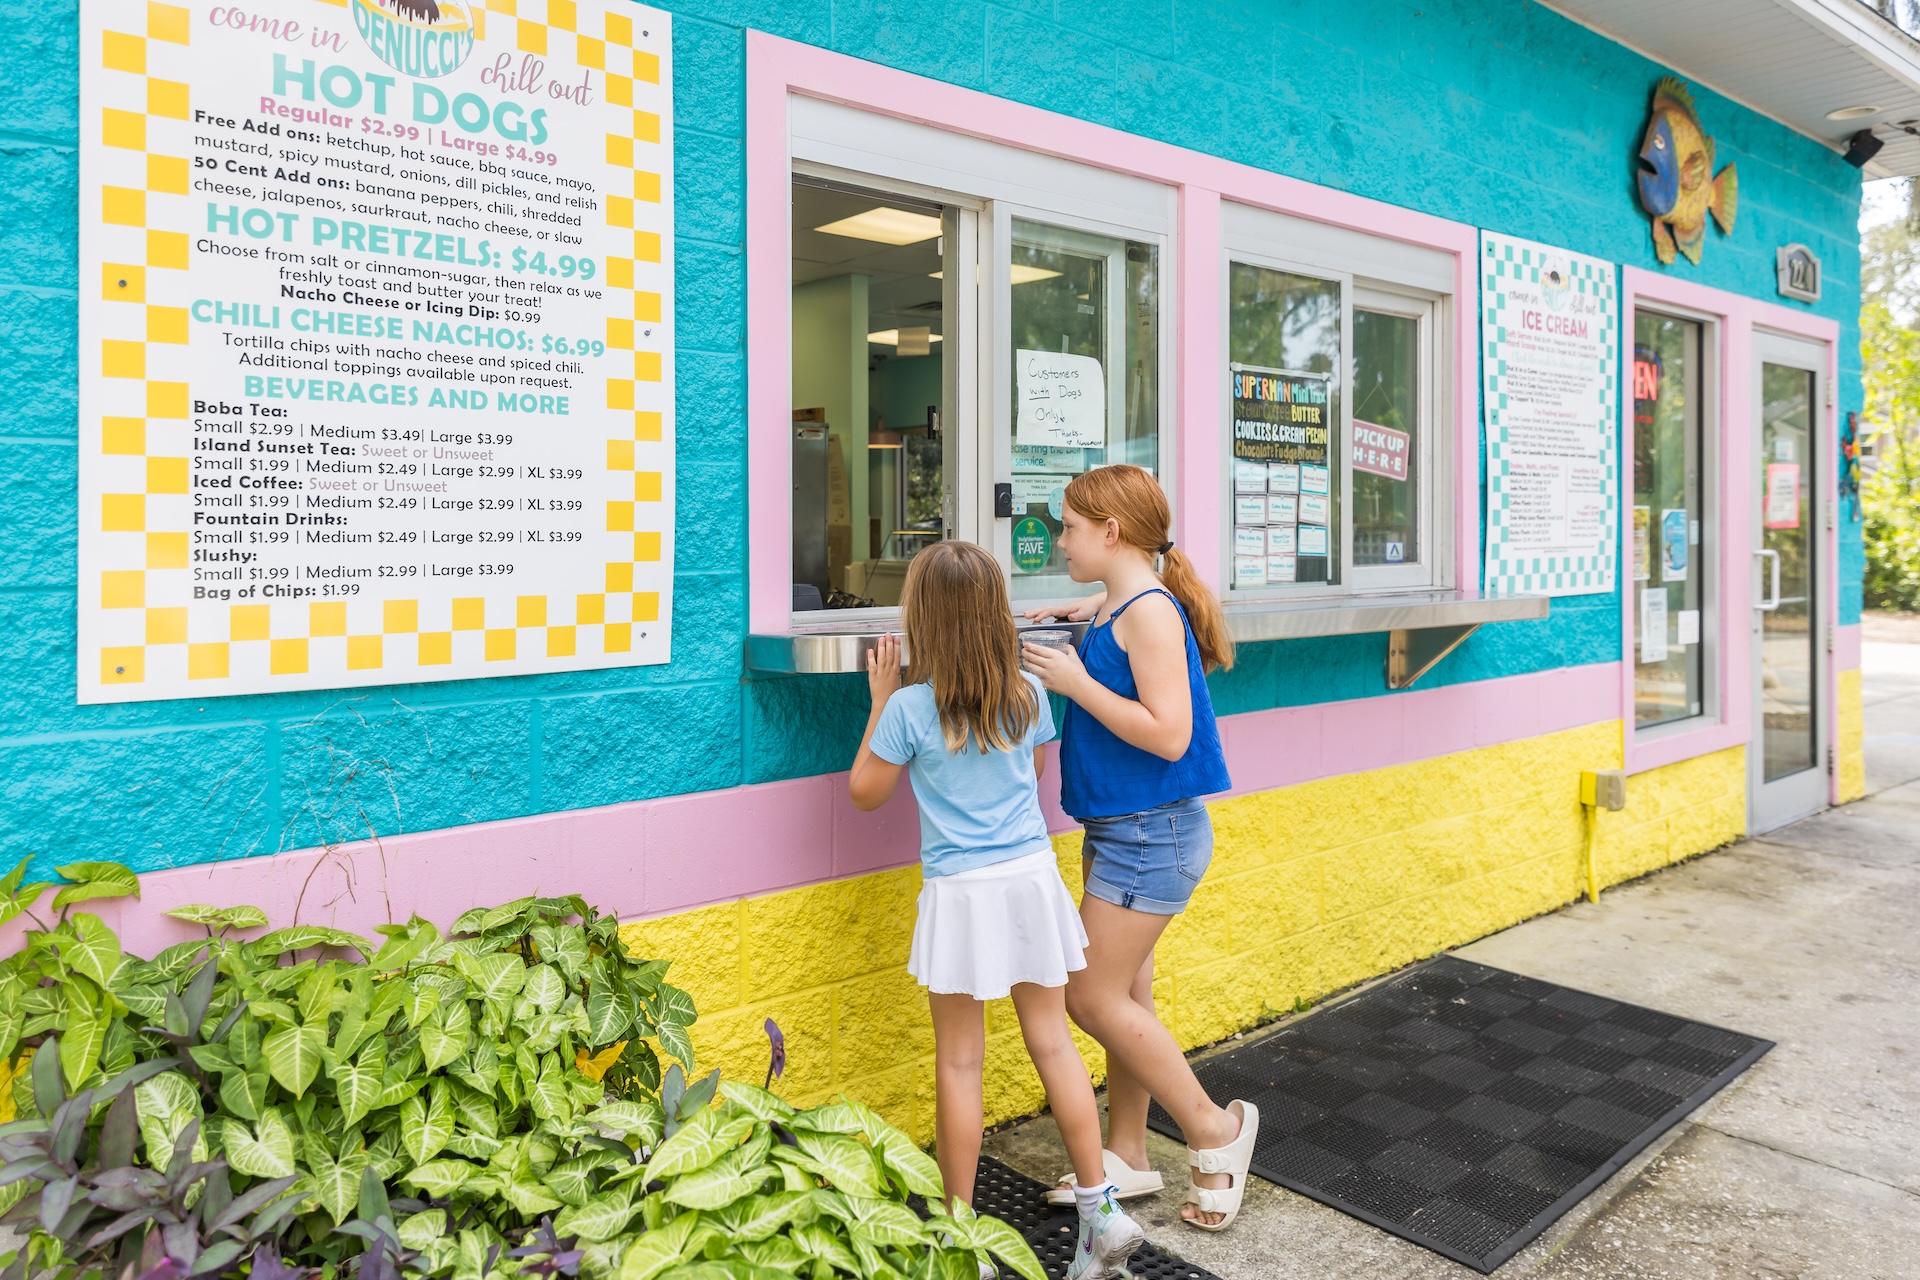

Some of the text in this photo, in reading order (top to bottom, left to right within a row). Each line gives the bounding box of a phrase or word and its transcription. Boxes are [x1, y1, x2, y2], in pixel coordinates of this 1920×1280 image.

[210, 6, 303, 42] come
[311, 25, 348, 53] in
[481, 53, 593, 107] chill out
[273, 54, 548, 145] HOT DOGS
[261, 97, 557, 166] Regular $2.99 Large $4.99
[194, 109, 596, 194] Free Add ons: ketchup, hot sauce, bbq sauce, mayo,
[195, 136, 597, 211] mustard, spicy mustard, onions, dill pickles, and relish
[193, 155, 582, 227] 50 Cent Add ons: banana peppers, chili, shredded
[193, 177, 583, 246] cheese, jalapenos, saurkraut, nacho cheese, or slaw
[208, 203, 595, 280] HOT PRETZELS: $4.99
[196, 238, 602, 300] Choose from salt or cinnamon-sugar, then relax as we
[278, 266, 542, 309] freshly toast and butter your treat!
[280, 284, 541, 324] Nacho Cheese or Icing Dip: $0.99
[192, 299, 604, 357] CHILI CHEESE NACHOS: $6.99
[1522, 309, 1588, 339] ICE CREAM
[221, 331, 584, 375] Tortilla chips with nacho cheese and spiced chili.
[1028, 358, 1079, 380] Customers
[245, 375, 569, 415] BEVERAGES AND MORE
[1030, 384, 1082, 400] with Dogs
[1234, 374, 1291, 403] SUPERMAN
[1291, 383, 1308, 404] Mint
[193, 399, 288, 418] Boba Tea:
[1291, 404, 1321, 424] BUTTER
[1235, 419, 1327, 444] COOKIES & CREAM PECAN
[1354, 426, 1404, 454] PICK UP
[193, 437, 494, 461] Island Sunset Tea: Sweet or Unsweet
[1015, 456, 1046, 466] service.
[1236, 440, 1274, 458] Chocolate
[1274, 444, 1297, 464] Fudge
[193, 474, 448, 493] Iced Coffee: Sweet or Unsweet
[193, 511, 348, 526] Fountain Drinks:
[193, 548, 258, 565] Slushy:
[1018, 542, 1044, 555] FAVE
[193, 583, 360, 601] Bag of Chips: $1.99
